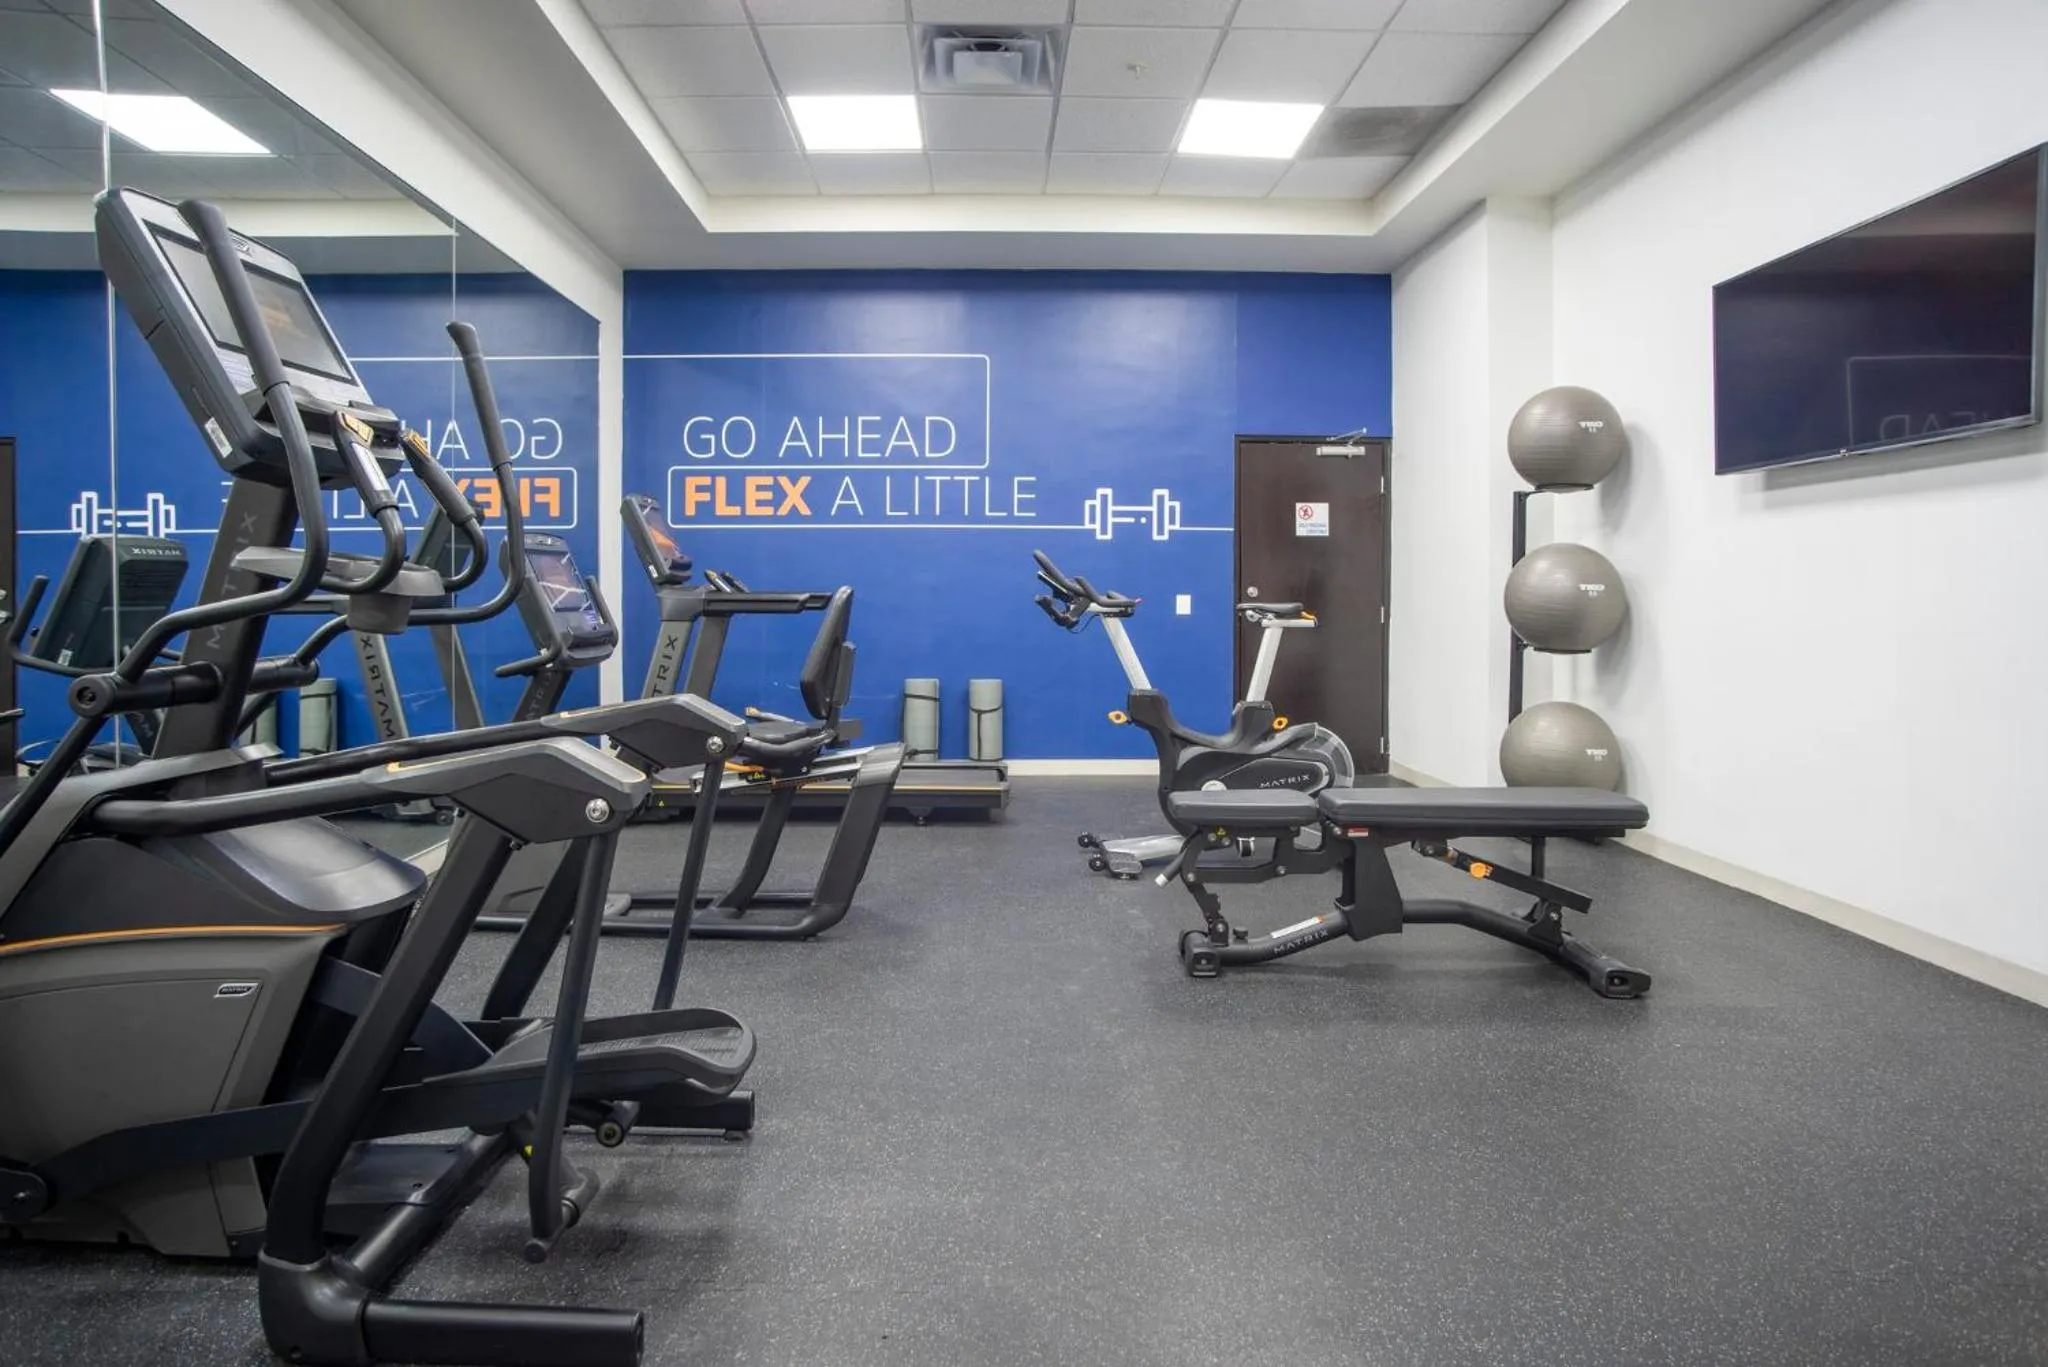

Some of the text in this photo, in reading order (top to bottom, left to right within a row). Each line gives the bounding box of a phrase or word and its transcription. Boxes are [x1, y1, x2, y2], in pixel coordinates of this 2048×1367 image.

[683, 416, 956, 458] GO AHEAD
[684, 475, 1036, 516] FLEX A LITTLE
[1259, 774, 1309, 789] MATRIX
